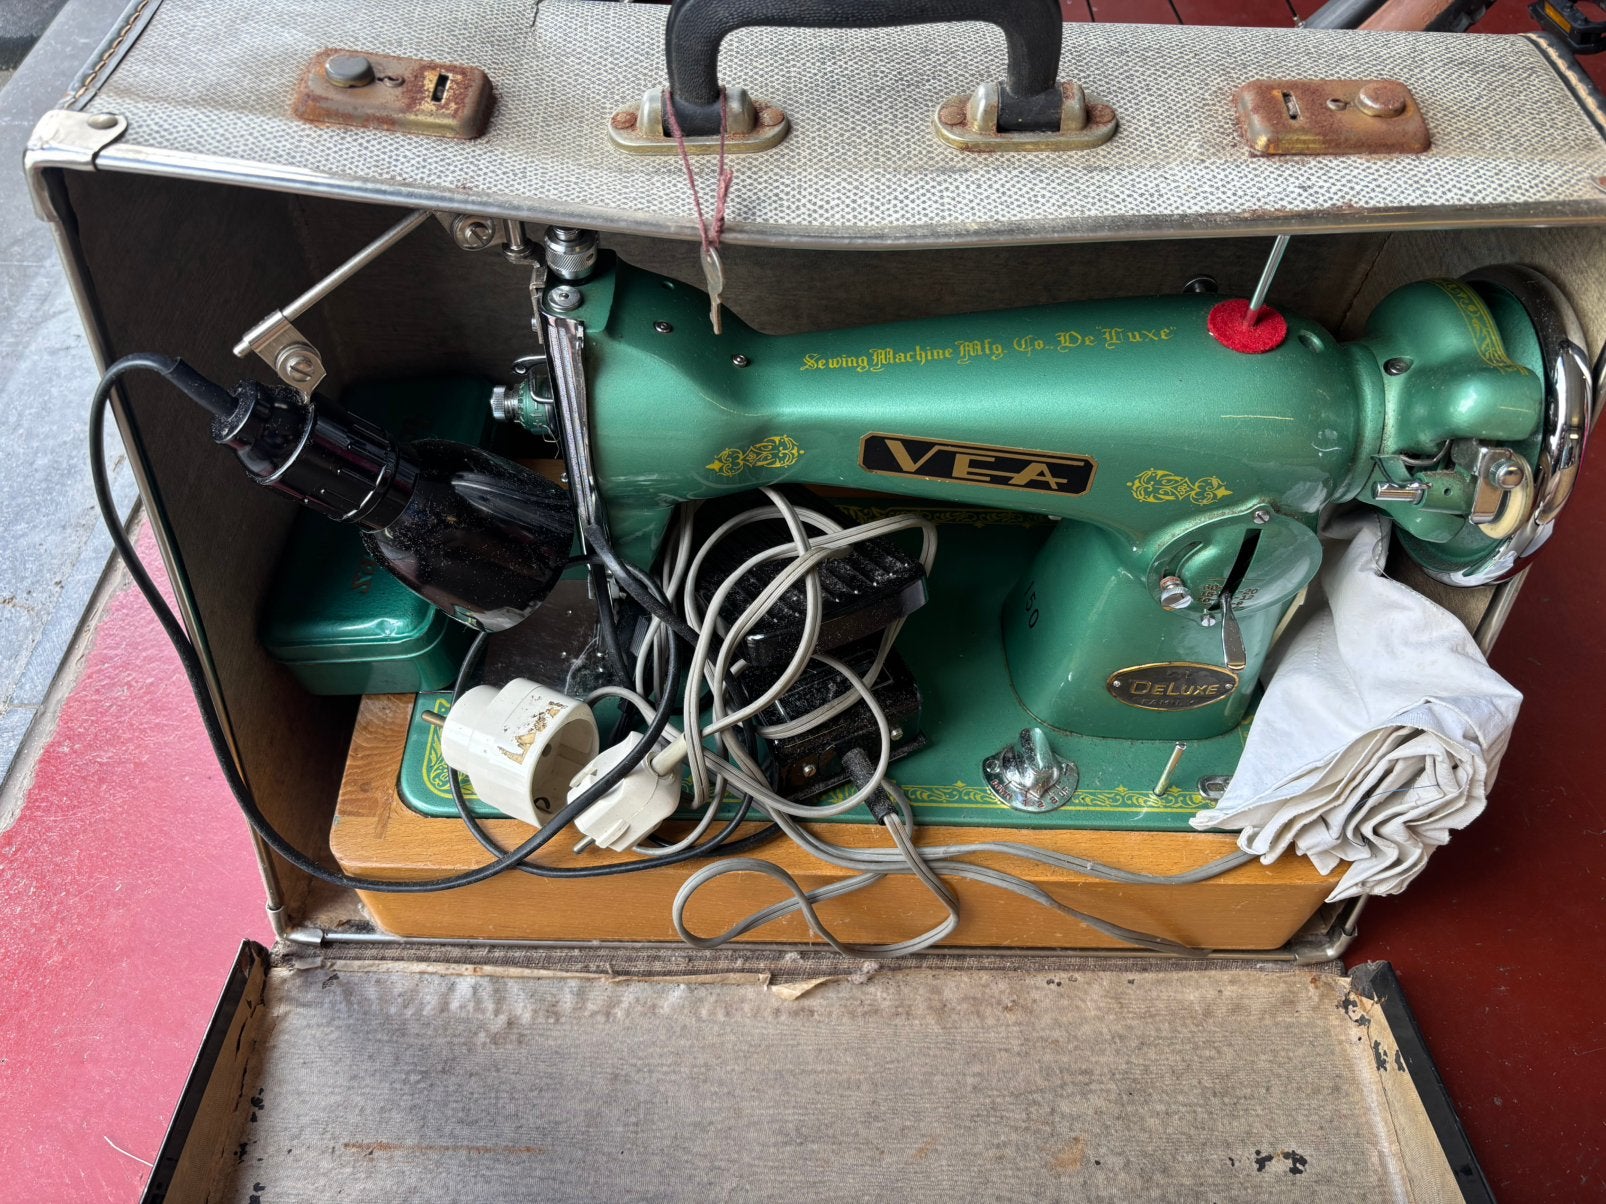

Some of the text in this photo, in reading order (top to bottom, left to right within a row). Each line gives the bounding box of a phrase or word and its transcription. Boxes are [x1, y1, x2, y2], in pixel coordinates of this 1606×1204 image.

[800, 353, 869, 373] Sewing
[869, 344, 953, 372] Machine
[1055, 331, 1097, 353] De
[884, 439, 1085, 490] VEA
